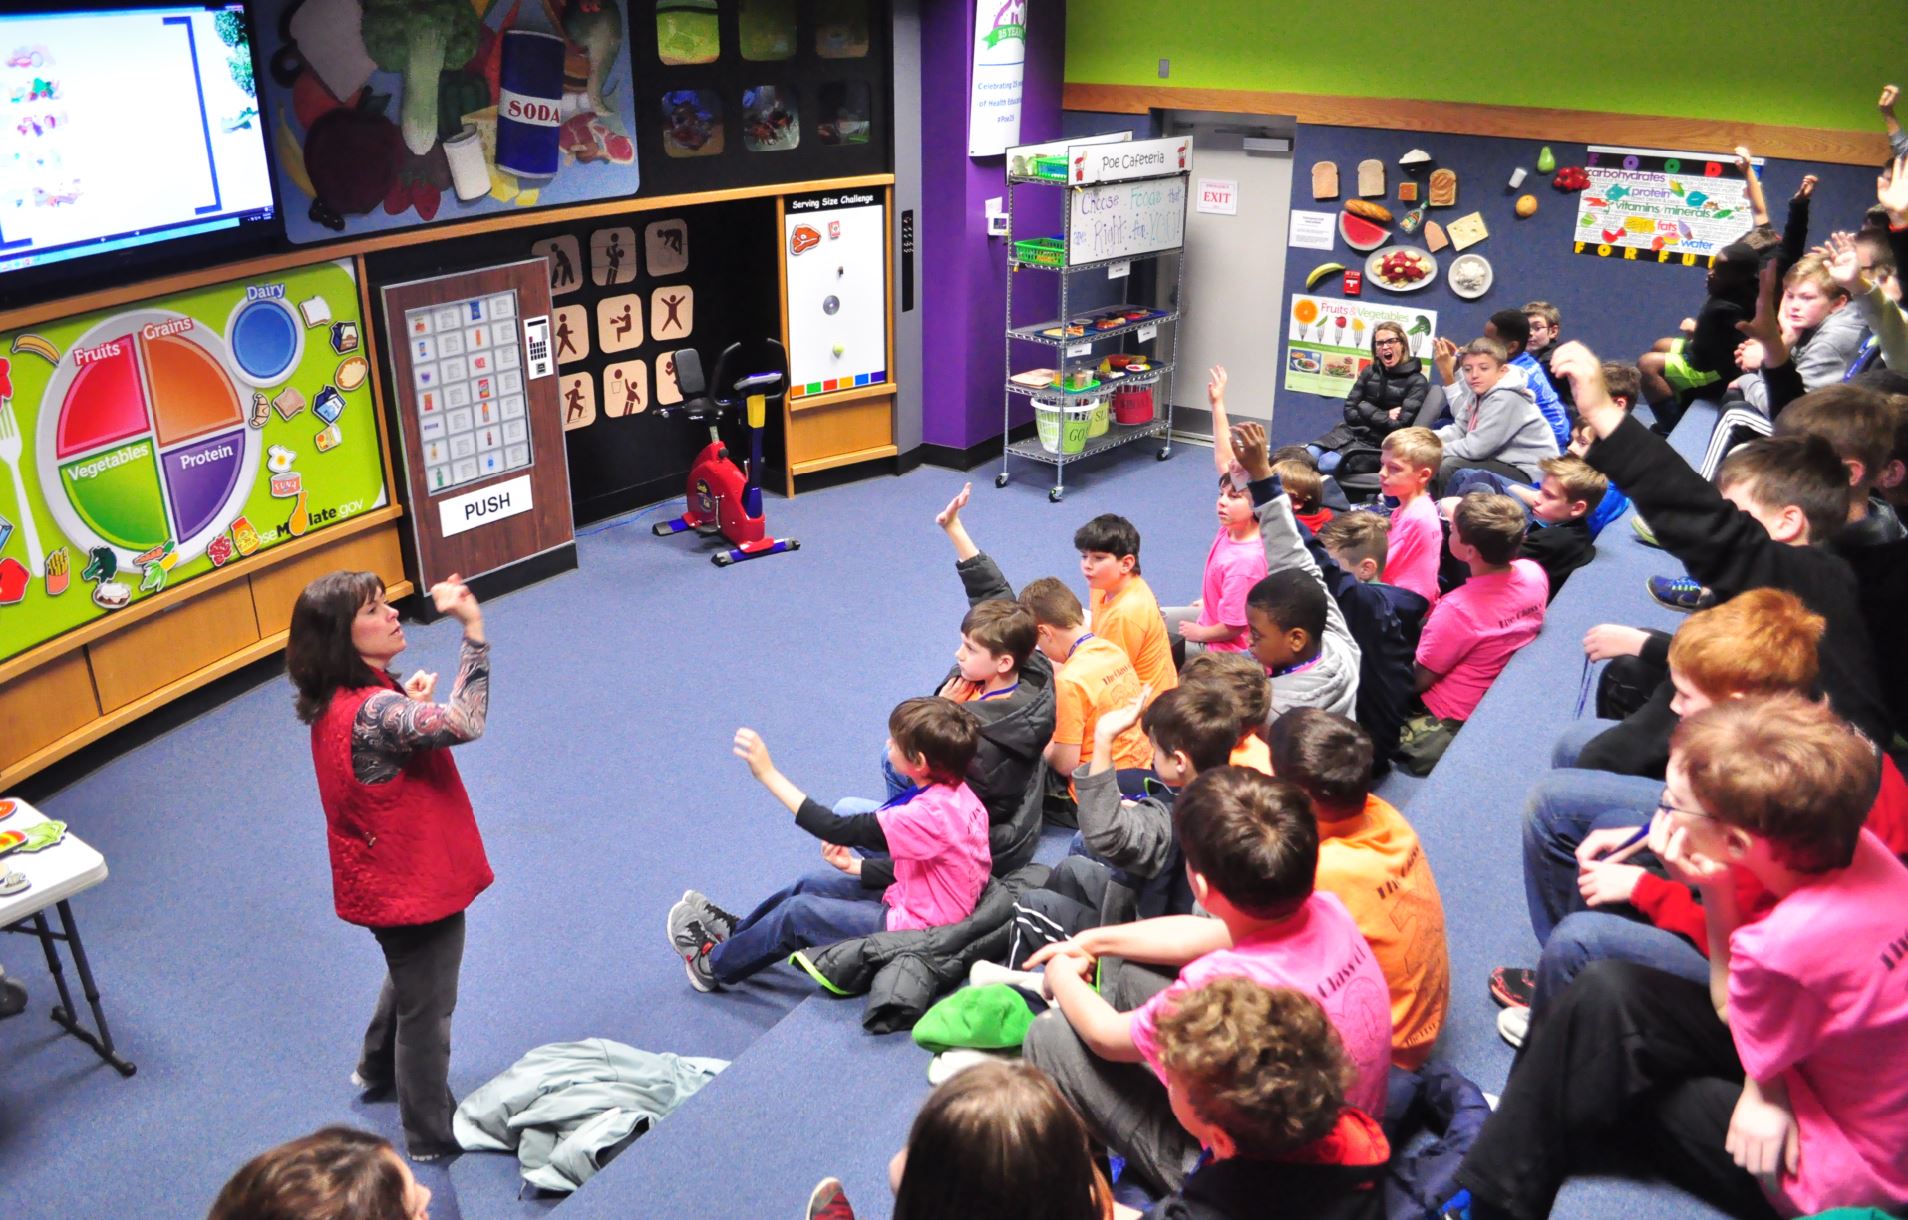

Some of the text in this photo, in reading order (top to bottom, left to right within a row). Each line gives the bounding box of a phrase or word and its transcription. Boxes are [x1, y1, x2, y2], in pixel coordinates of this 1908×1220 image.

[508, 100, 560, 123] SODA
[1102, 152, 1165, 171] Poe Cafeteria
[1587, 168, 1666, 183] carbohydrates
[792, 194, 874, 210] Serving Size Challenge
[1203, 191, 1232, 204] EXIT
[1631, 187, 1671, 199] protein
[1615, 201, 1660, 214] vitamins
[1664, 205, 1711, 218] minerals
[1657, 219, 1678, 232] fats
[1574, 241, 1638, 261] FOR
[1681, 239, 1714, 250] water
[247, 283, 285, 300] Dairy
[1321, 302, 1410, 322] Fruits & Vegetables
[143, 318, 193, 341] Grains
[74, 344, 121, 367] Fruits
[67, 444, 149, 481] Vegetables
[180, 444, 234, 470] Protein
[464, 491, 511, 521] PUSH
